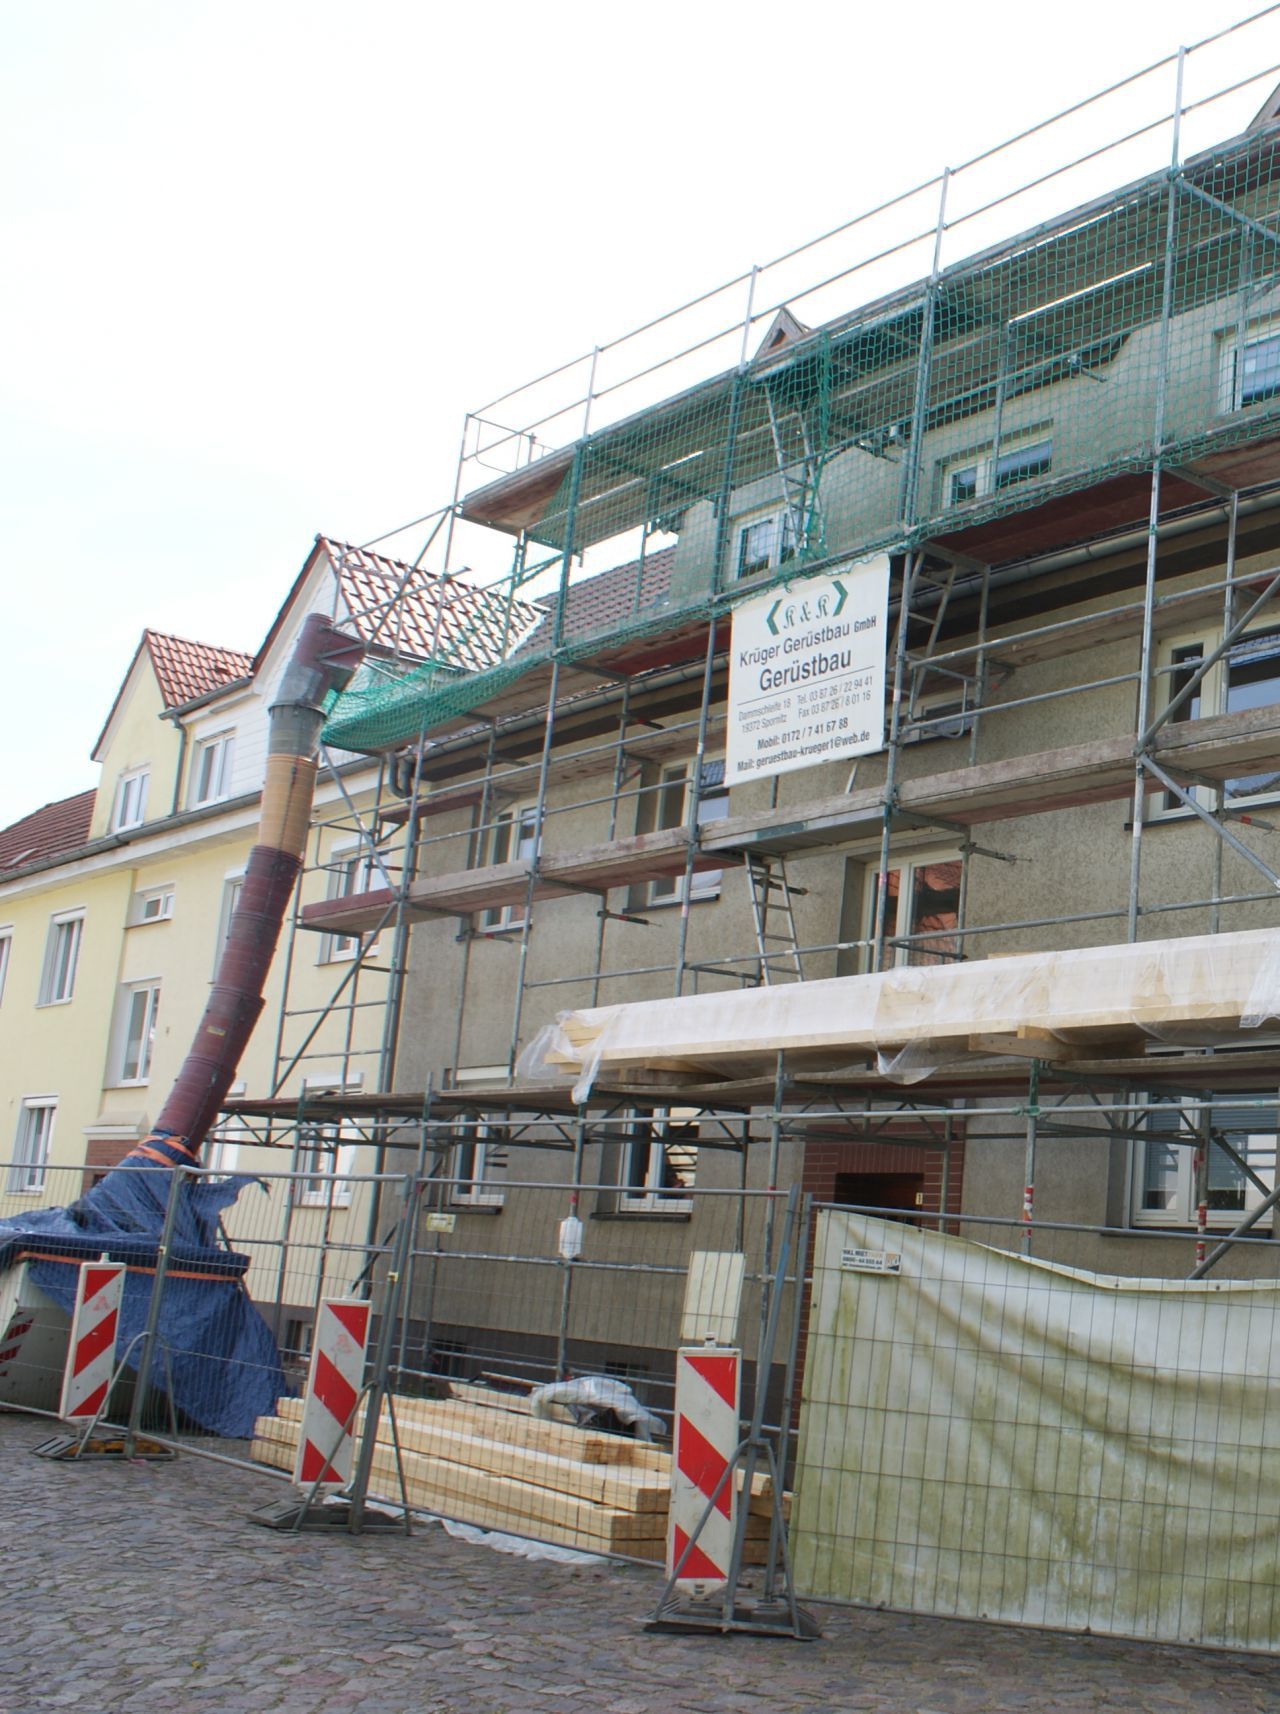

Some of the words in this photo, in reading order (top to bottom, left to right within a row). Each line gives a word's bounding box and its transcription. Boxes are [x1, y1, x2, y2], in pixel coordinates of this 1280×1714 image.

[800, 601, 812, 623] &
[740, 644, 780, 668] Krüger
[783, 623, 850, 655] Gerüstbau
[854, 615, 877, 633] GmbH
[759, 649, 852, 692] Gerüstbau
[864, 676, 873, 687] 41
[798, 708, 810, 719] Fax
[852, 693, 860, 704] 01
[757, 736, 779, 750] Mobil:
[781, 729, 800, 744] 0172
[814, 722, 824, 734] 41
[737, 758, 755, 772] Mail:
